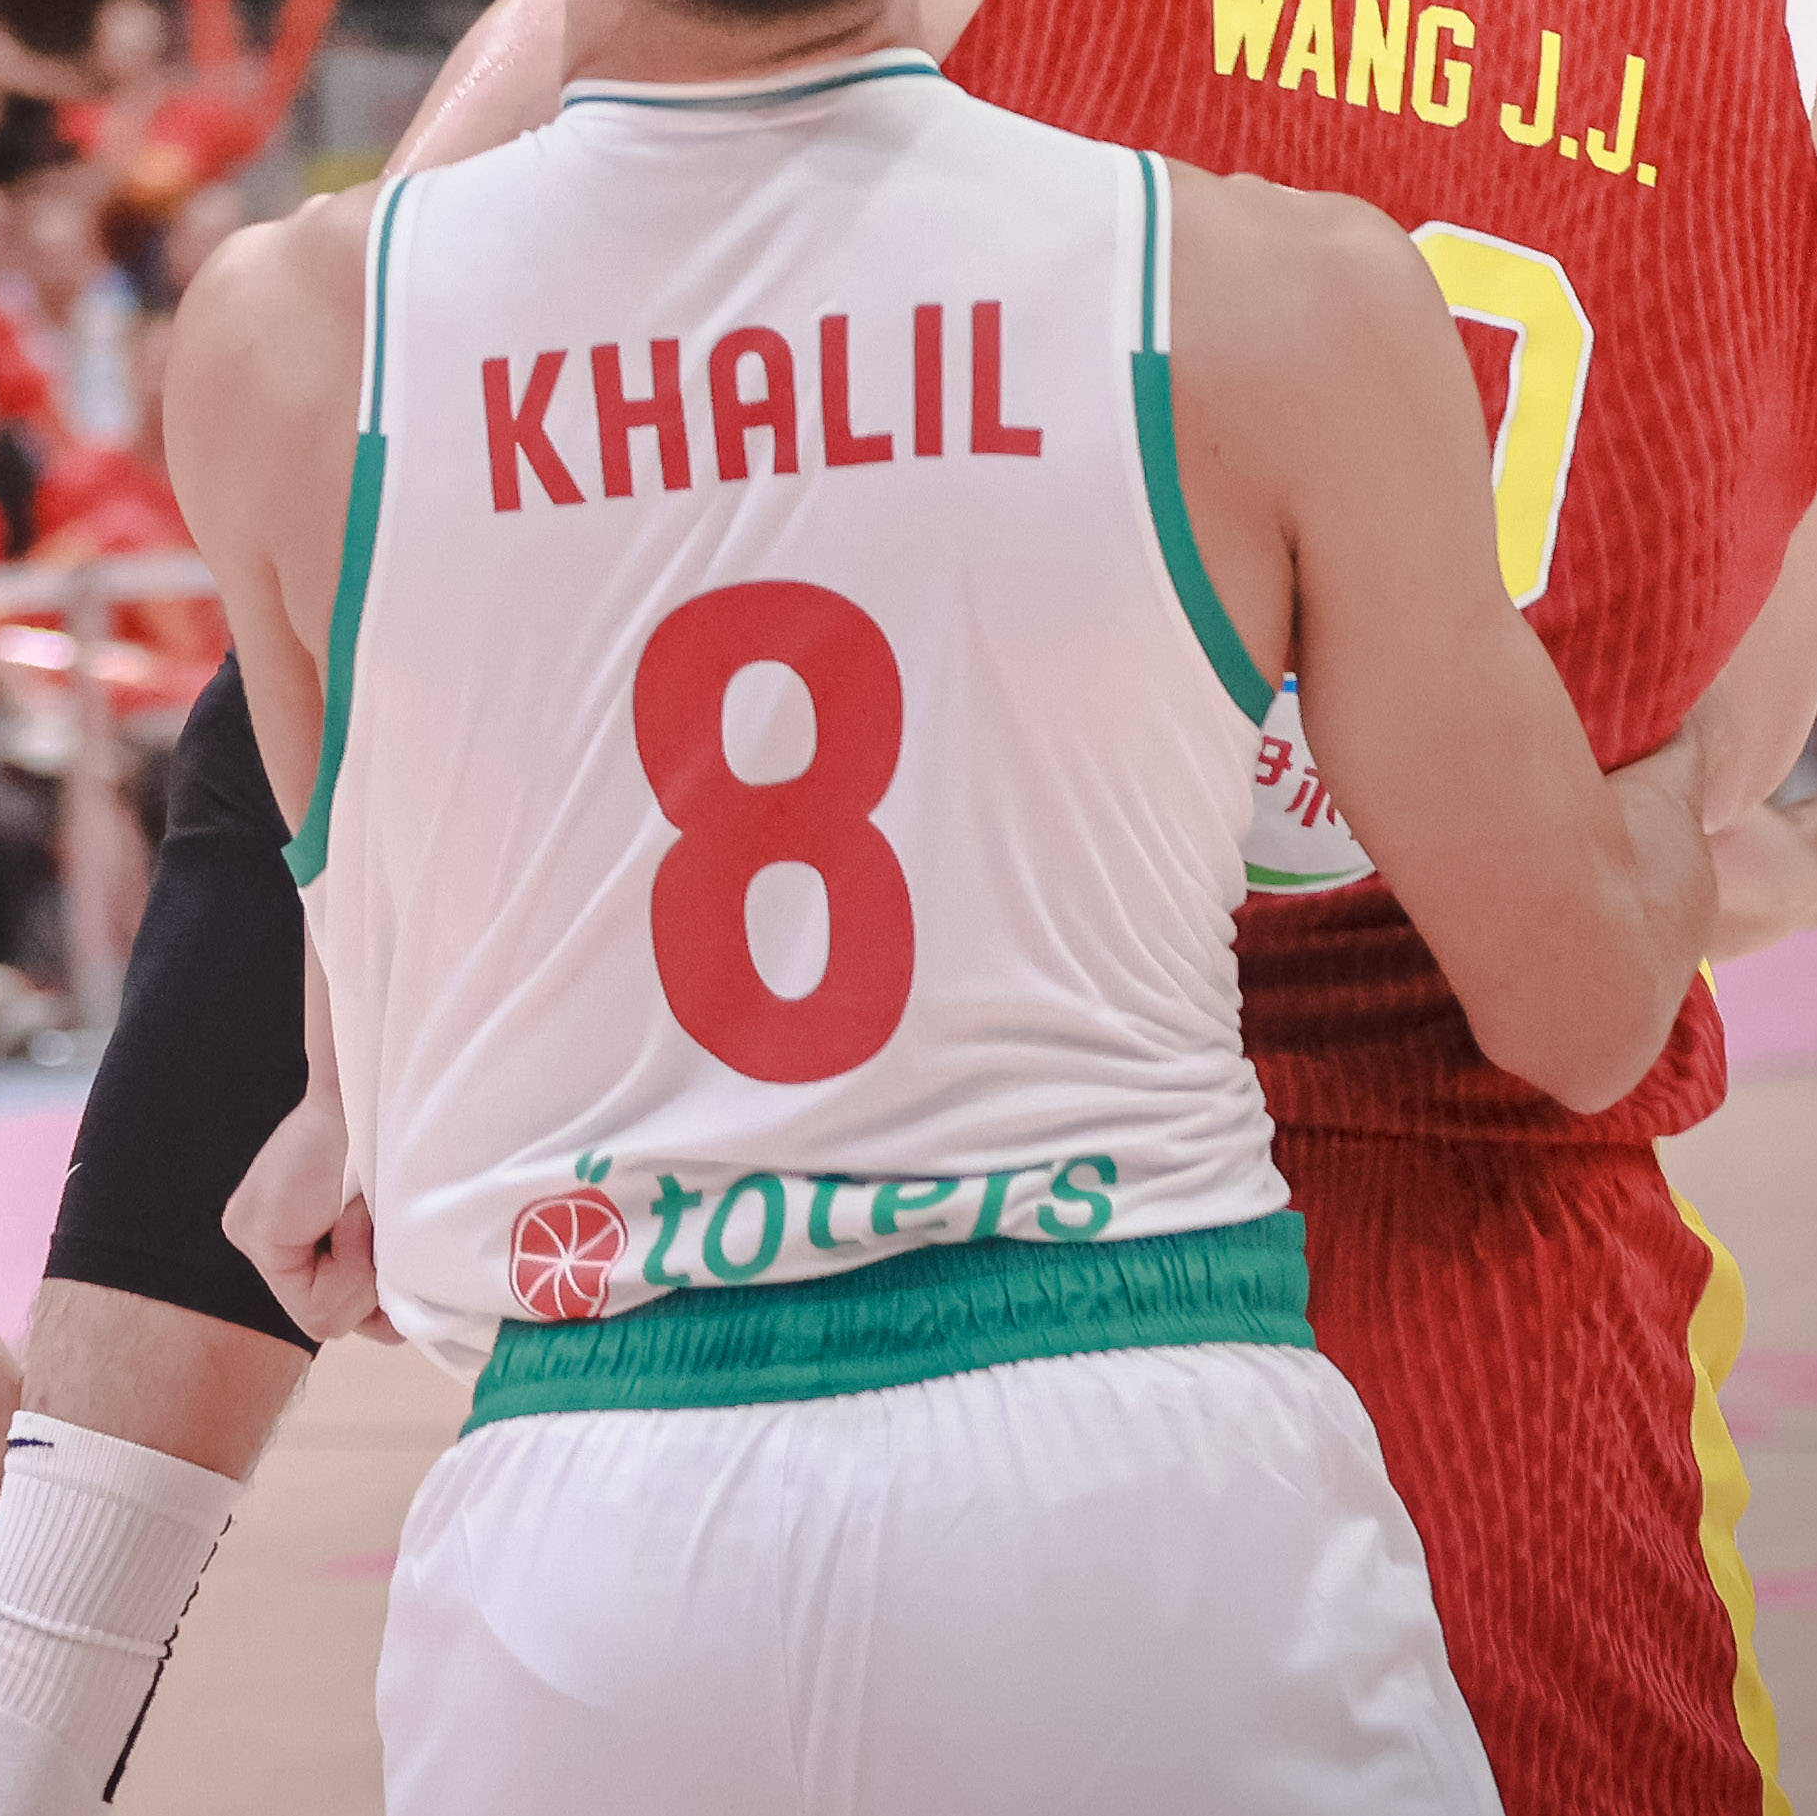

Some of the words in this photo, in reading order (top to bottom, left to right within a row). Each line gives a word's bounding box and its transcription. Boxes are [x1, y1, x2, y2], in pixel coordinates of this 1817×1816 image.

[1500, 29, 1658, 188] J.J.
[481, 299, 1044, 513] KHALIL
[633, 578, 915, 1084] 8
